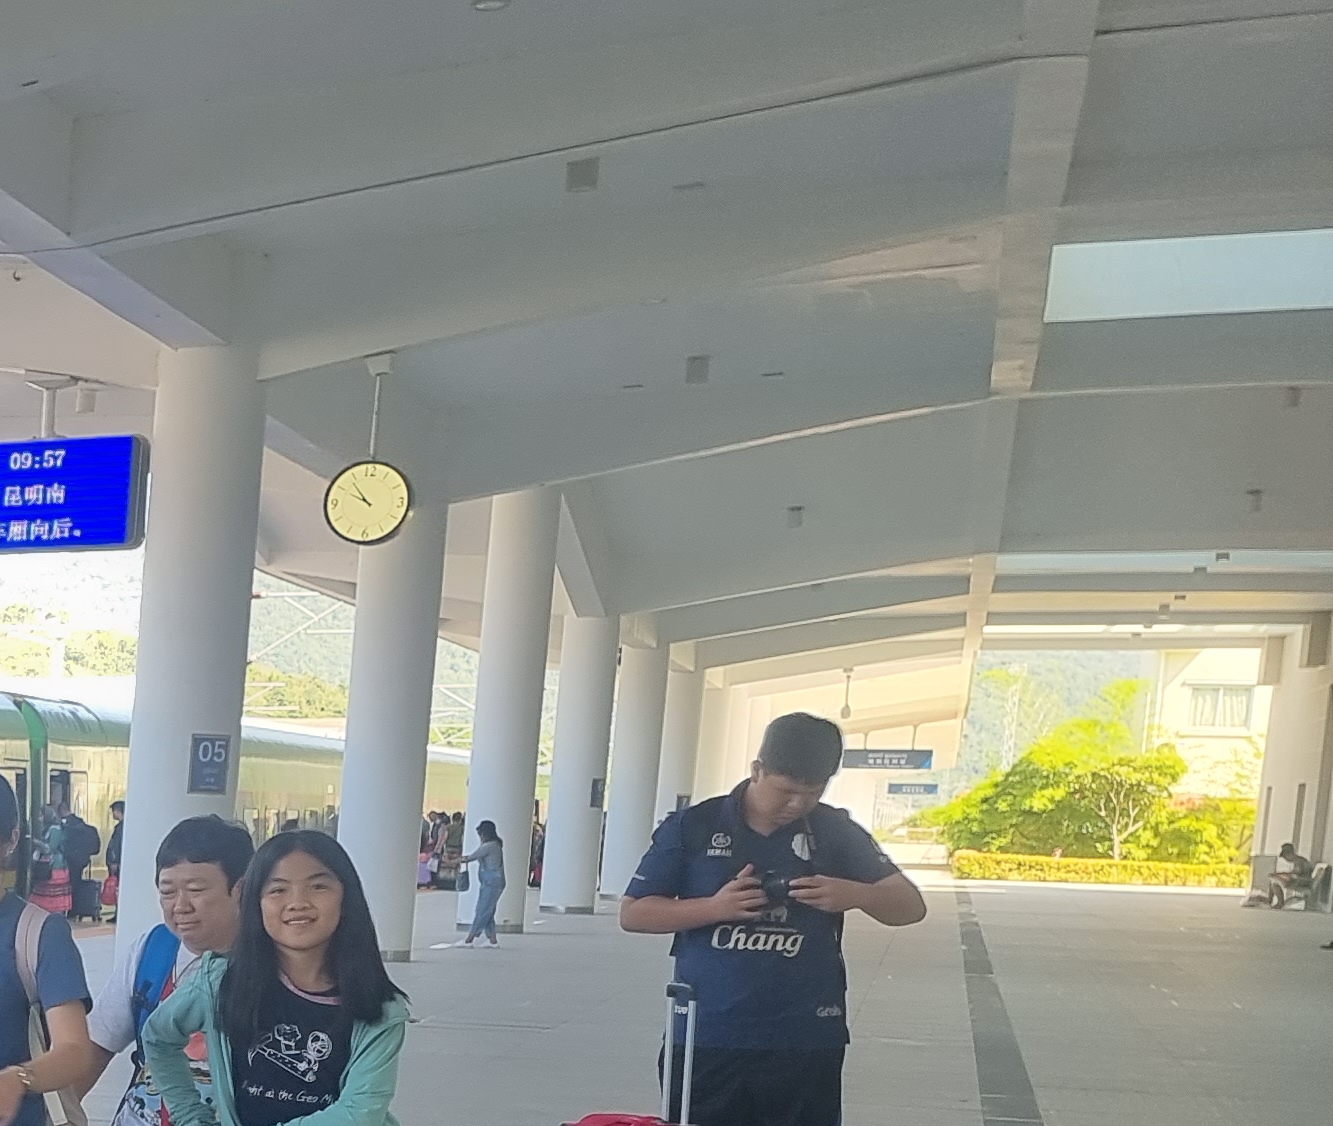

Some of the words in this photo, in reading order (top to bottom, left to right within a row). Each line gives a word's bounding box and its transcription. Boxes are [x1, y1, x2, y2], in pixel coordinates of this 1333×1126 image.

[10, 449, 66, 470] 09:57
[364, 465, 377, 477] 12
[3, 482, 66, 507] 昆明南
[396, 497, 405, 508] 3
[331, 498, 339, 510] 9
[361, 527, 369, 539] 6
[198, 740, 227, 762] 05
[711, 925, 805, 958] Chang
[278, 1088, 294, 1101] the
[296, 1090, 319, 1103] Geo
[320, 1093, 334, 1106] M
